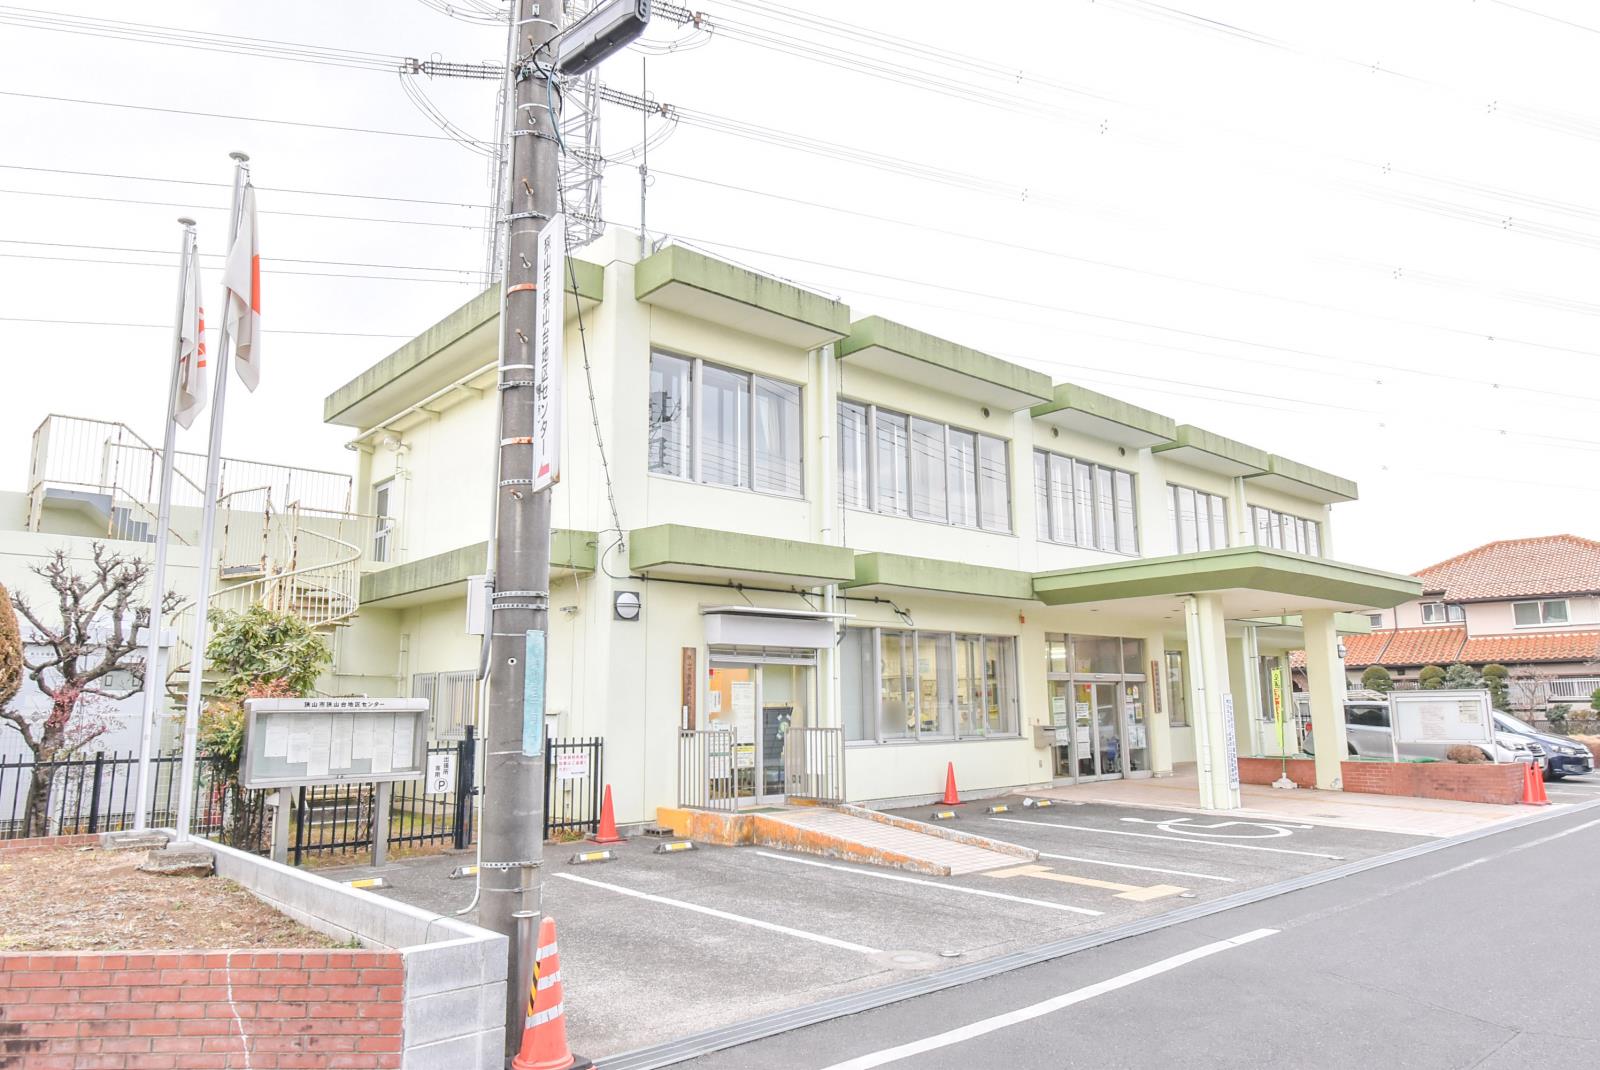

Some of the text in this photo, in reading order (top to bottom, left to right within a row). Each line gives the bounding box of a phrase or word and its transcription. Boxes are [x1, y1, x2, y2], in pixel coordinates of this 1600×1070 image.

[540, 234, 552, 456] 狭山市狭山台地区センター
